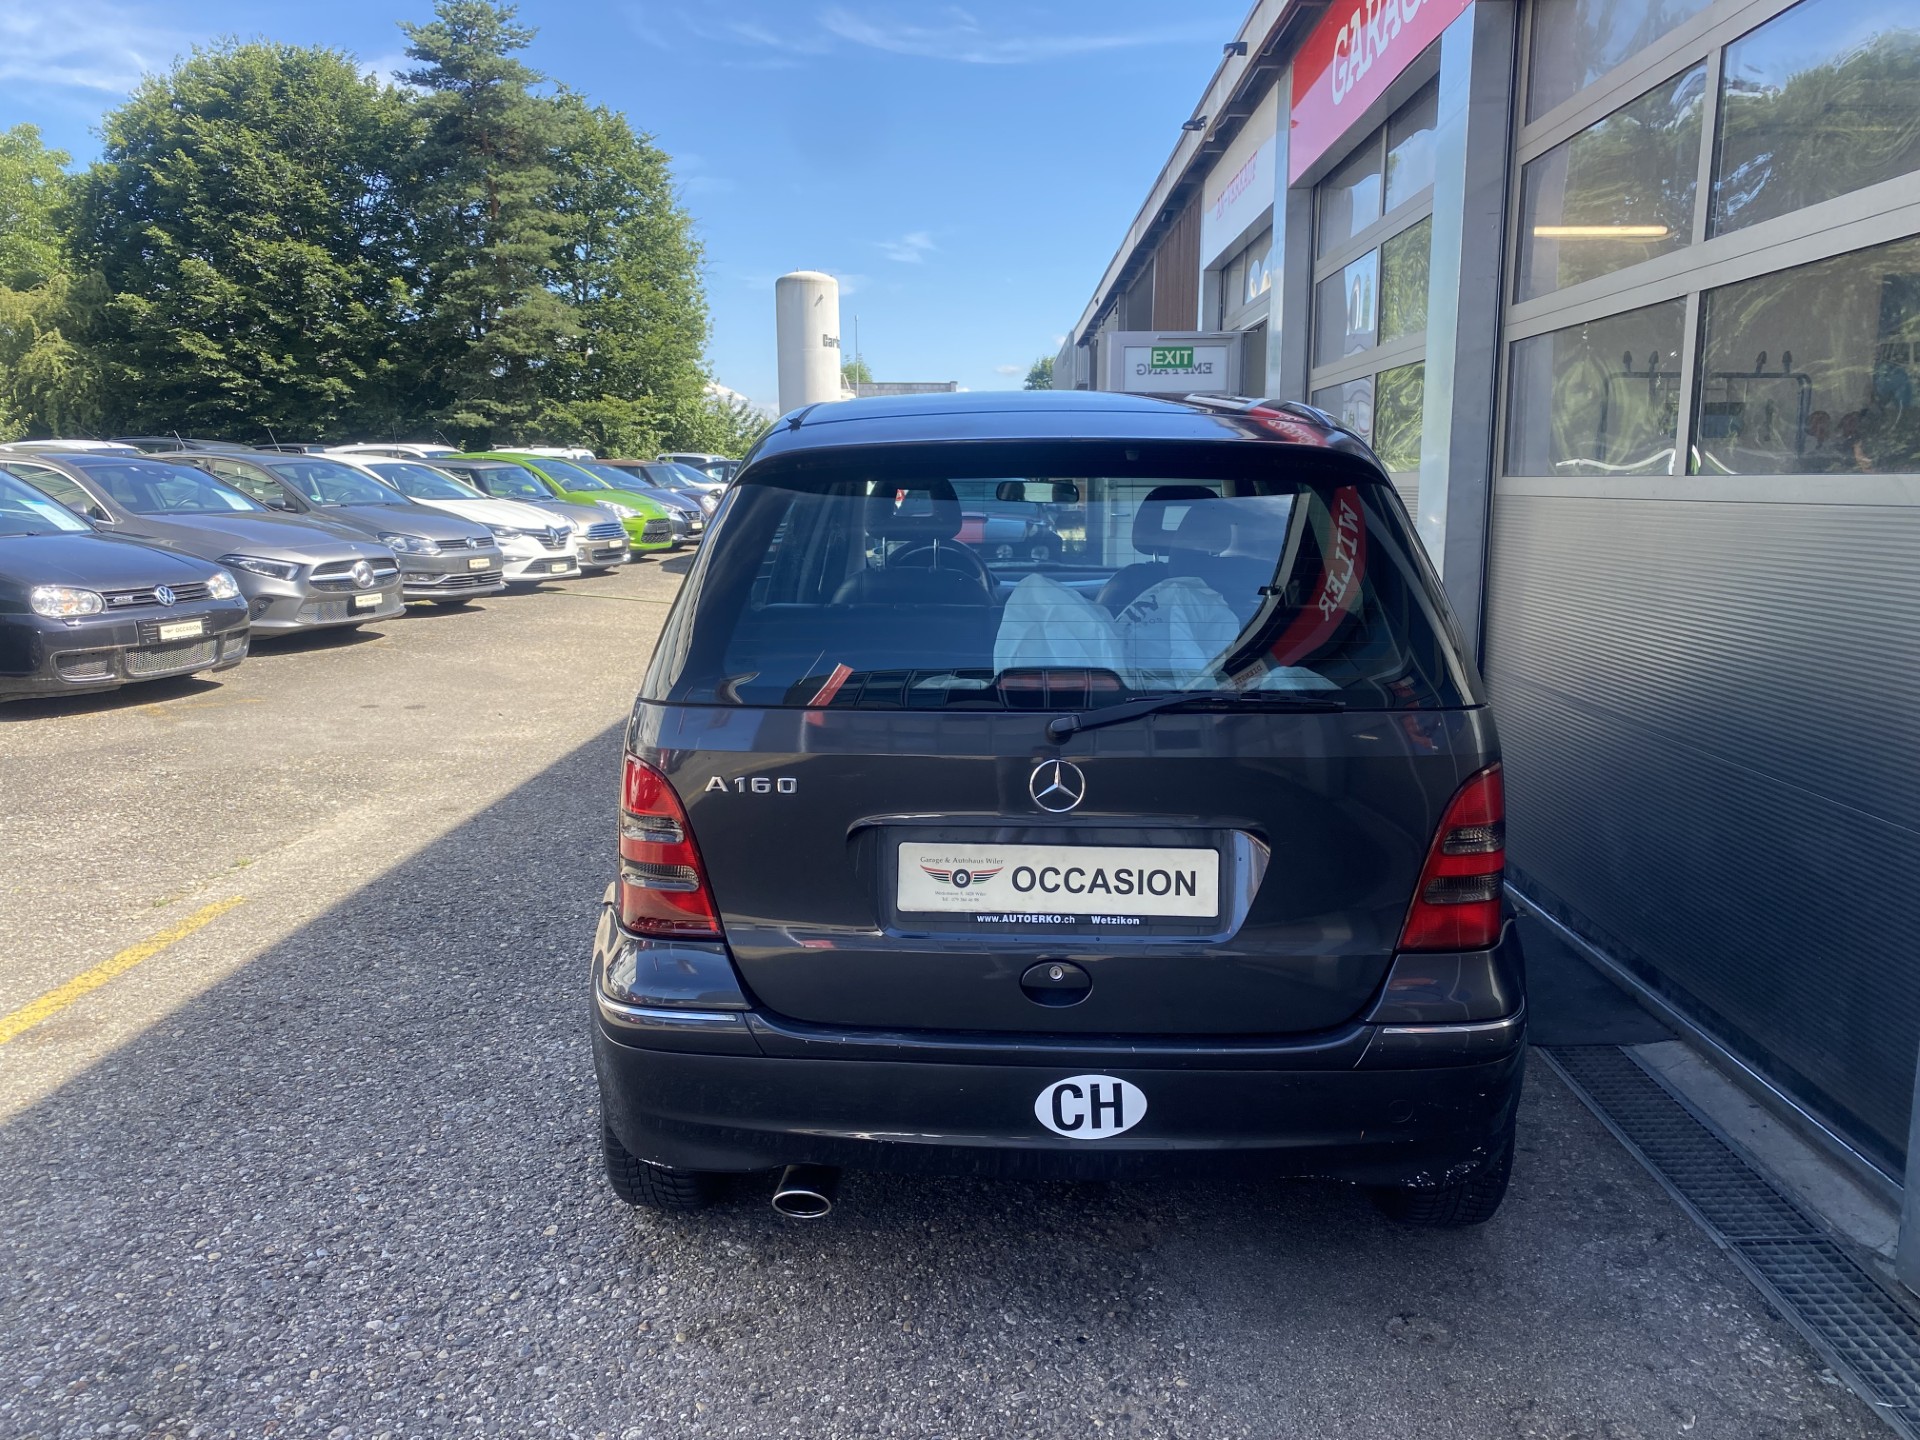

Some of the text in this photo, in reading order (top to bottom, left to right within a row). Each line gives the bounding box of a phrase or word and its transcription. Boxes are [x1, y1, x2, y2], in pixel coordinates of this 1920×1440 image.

[1332, 0, 1428, 105] GARA
[1152, 350, 1192, 365] EXIT
[920, 856, 943, 864] Garage
[985, 857, 1004, 865] Wiler
[1011, 866, 1196, 897] OCCASION
[976, 914, 1140, 925] www.AUTOERKO.ch Wetzikon
[1051, 1083, 1124, 1131] CH
